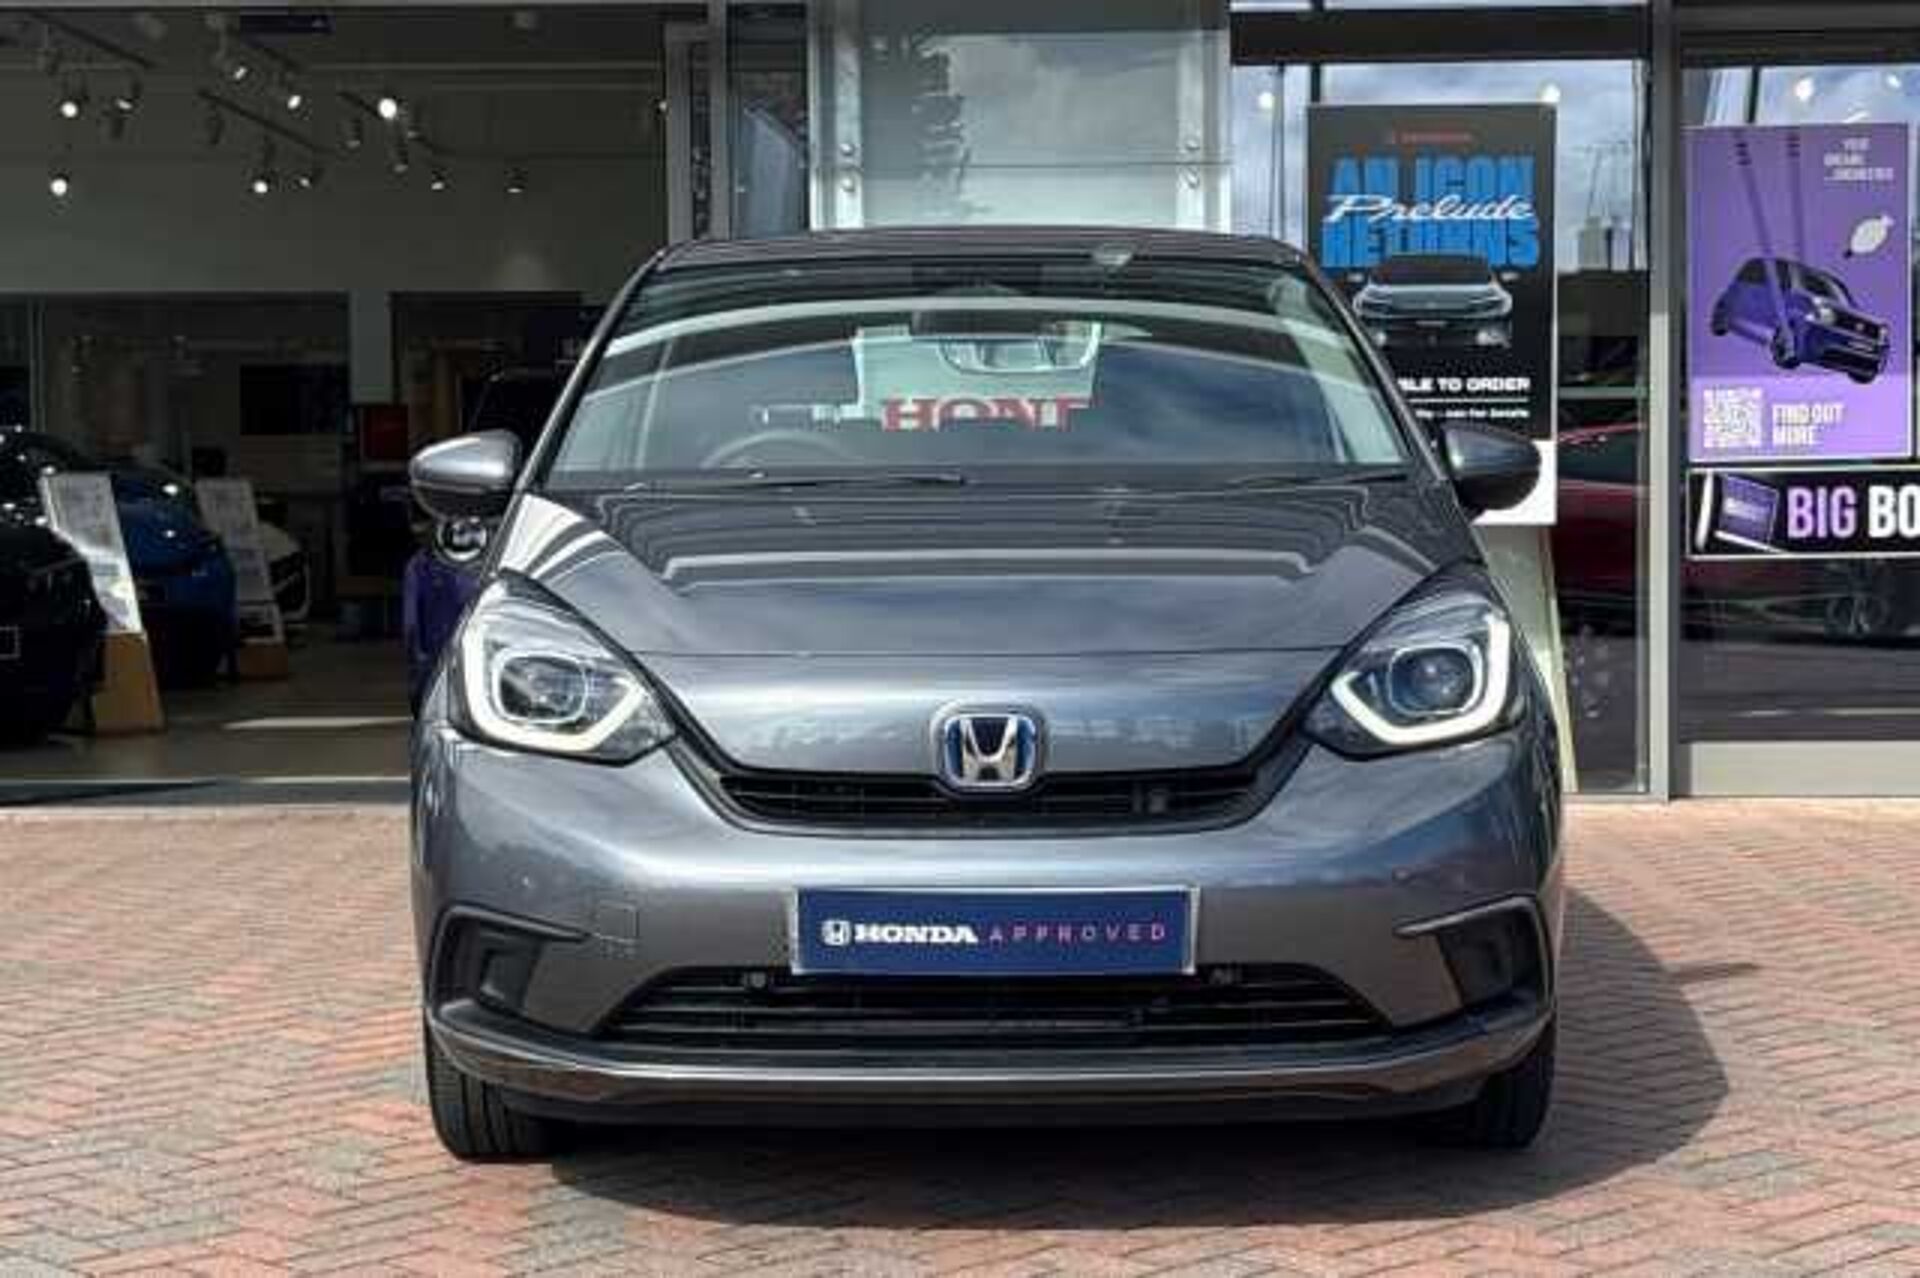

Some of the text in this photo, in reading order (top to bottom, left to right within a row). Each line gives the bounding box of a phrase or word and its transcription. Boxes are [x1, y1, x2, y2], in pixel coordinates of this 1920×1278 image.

[1322, 194, 1535, 224] Prelude
[1437, 377, 1462, 391] TO
[1787, 485, 1856, 538] BIG
[854, 922, 1165, 944] HONDA APPROVED
